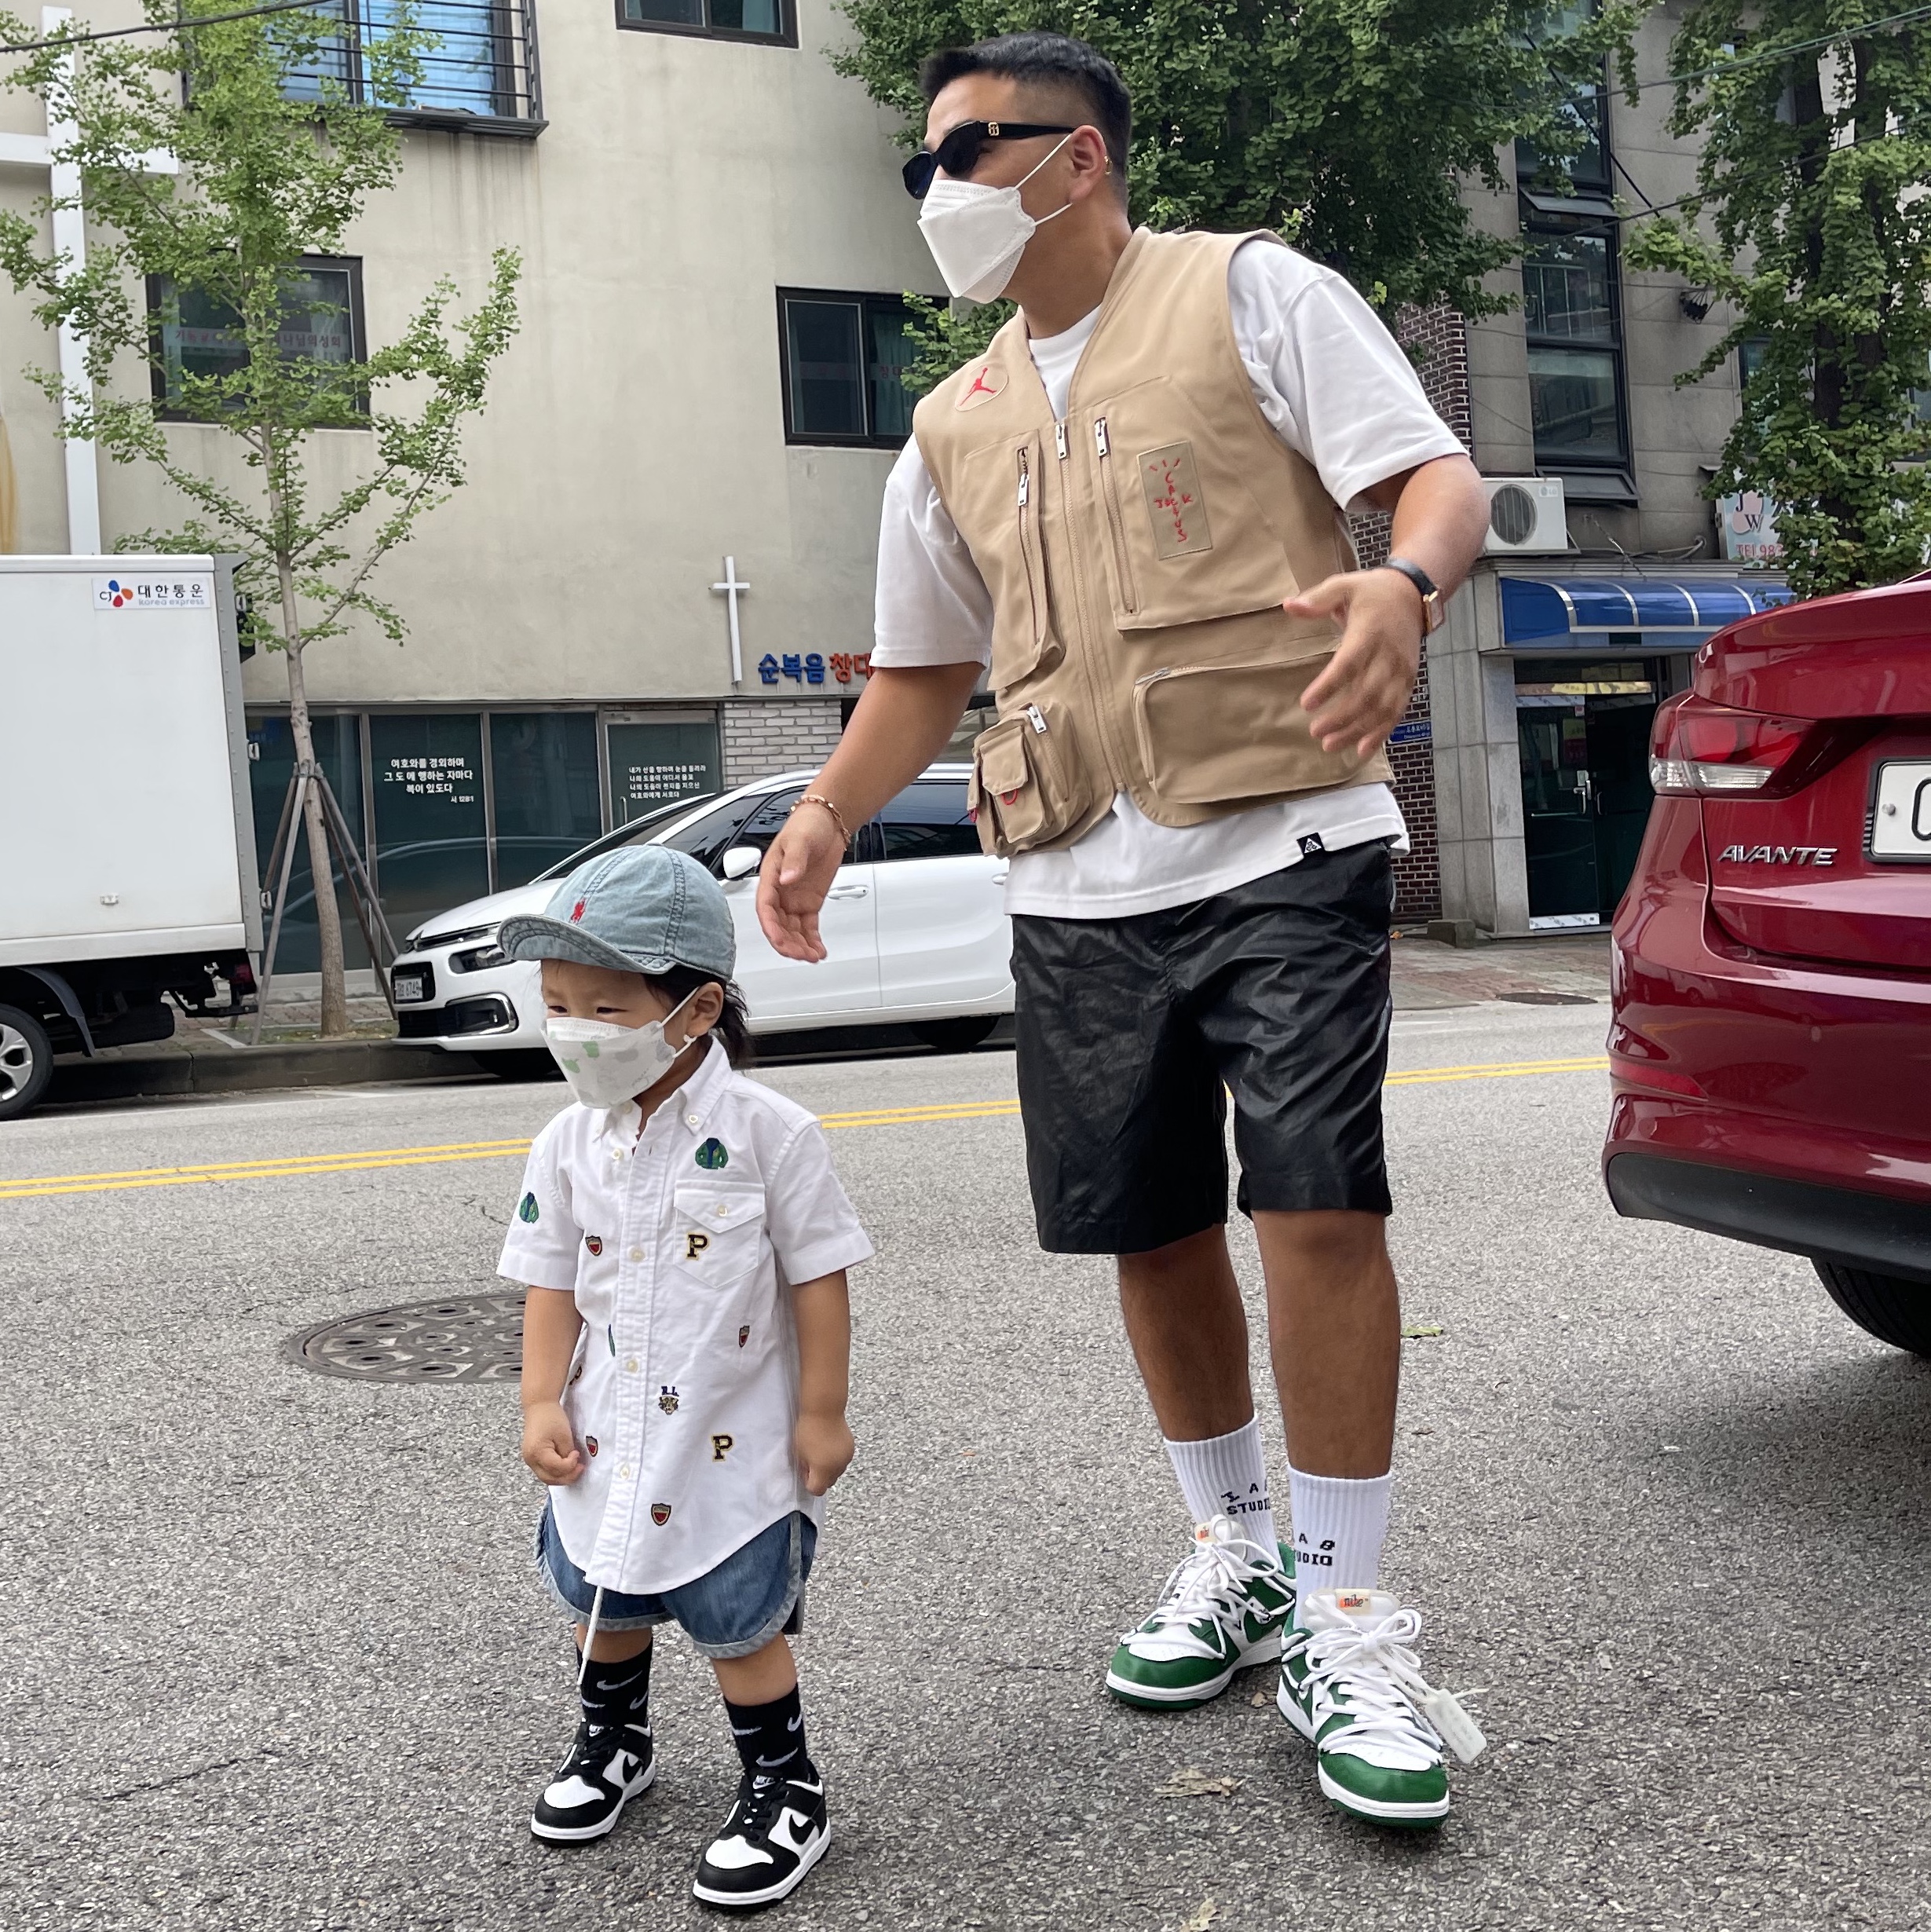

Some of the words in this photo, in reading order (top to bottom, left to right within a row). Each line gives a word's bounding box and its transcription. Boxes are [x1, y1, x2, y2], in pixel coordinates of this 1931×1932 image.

[99, 591, 112, 602] CJ
[137, 584, 203, 598] 대한통운
[169, 598, 205, 607] express
[758, 653, 825, 683] 순복음
[1717, 845, 1838, 866] AVANTE
[685, 1232, 709, 1261] P
[711, 1433, 736, 1462] P
[1227, 1498, 1271, 1516] STUDI
